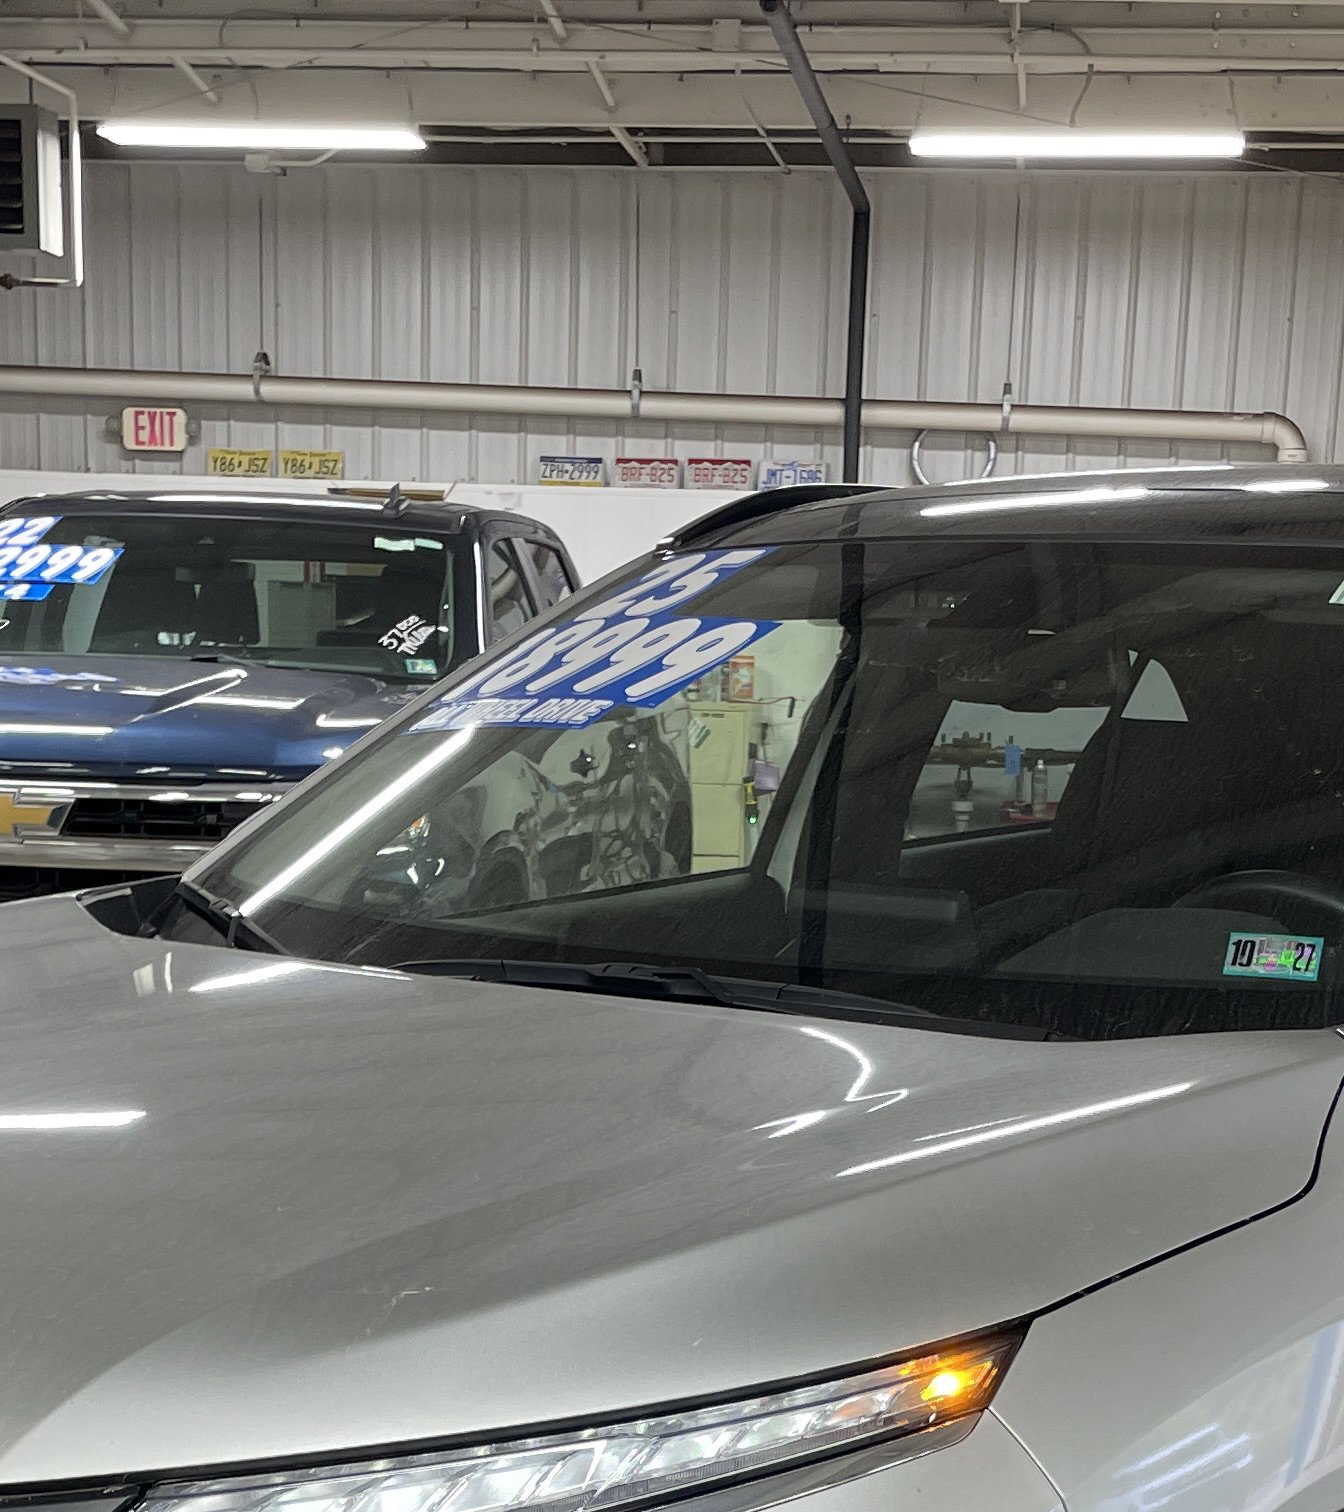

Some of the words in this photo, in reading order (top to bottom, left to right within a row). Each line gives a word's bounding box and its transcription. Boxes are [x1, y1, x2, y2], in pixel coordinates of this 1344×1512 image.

[134, 411, 177, 446] EXIT
[573, 550, 767, 622] 25
[440, 618, 758, 701] 18999
[519, 698, 614, 724] DRIVE
[1230, 939, 1256, 967] 10
[1292, 943, 1317, 972] 27
